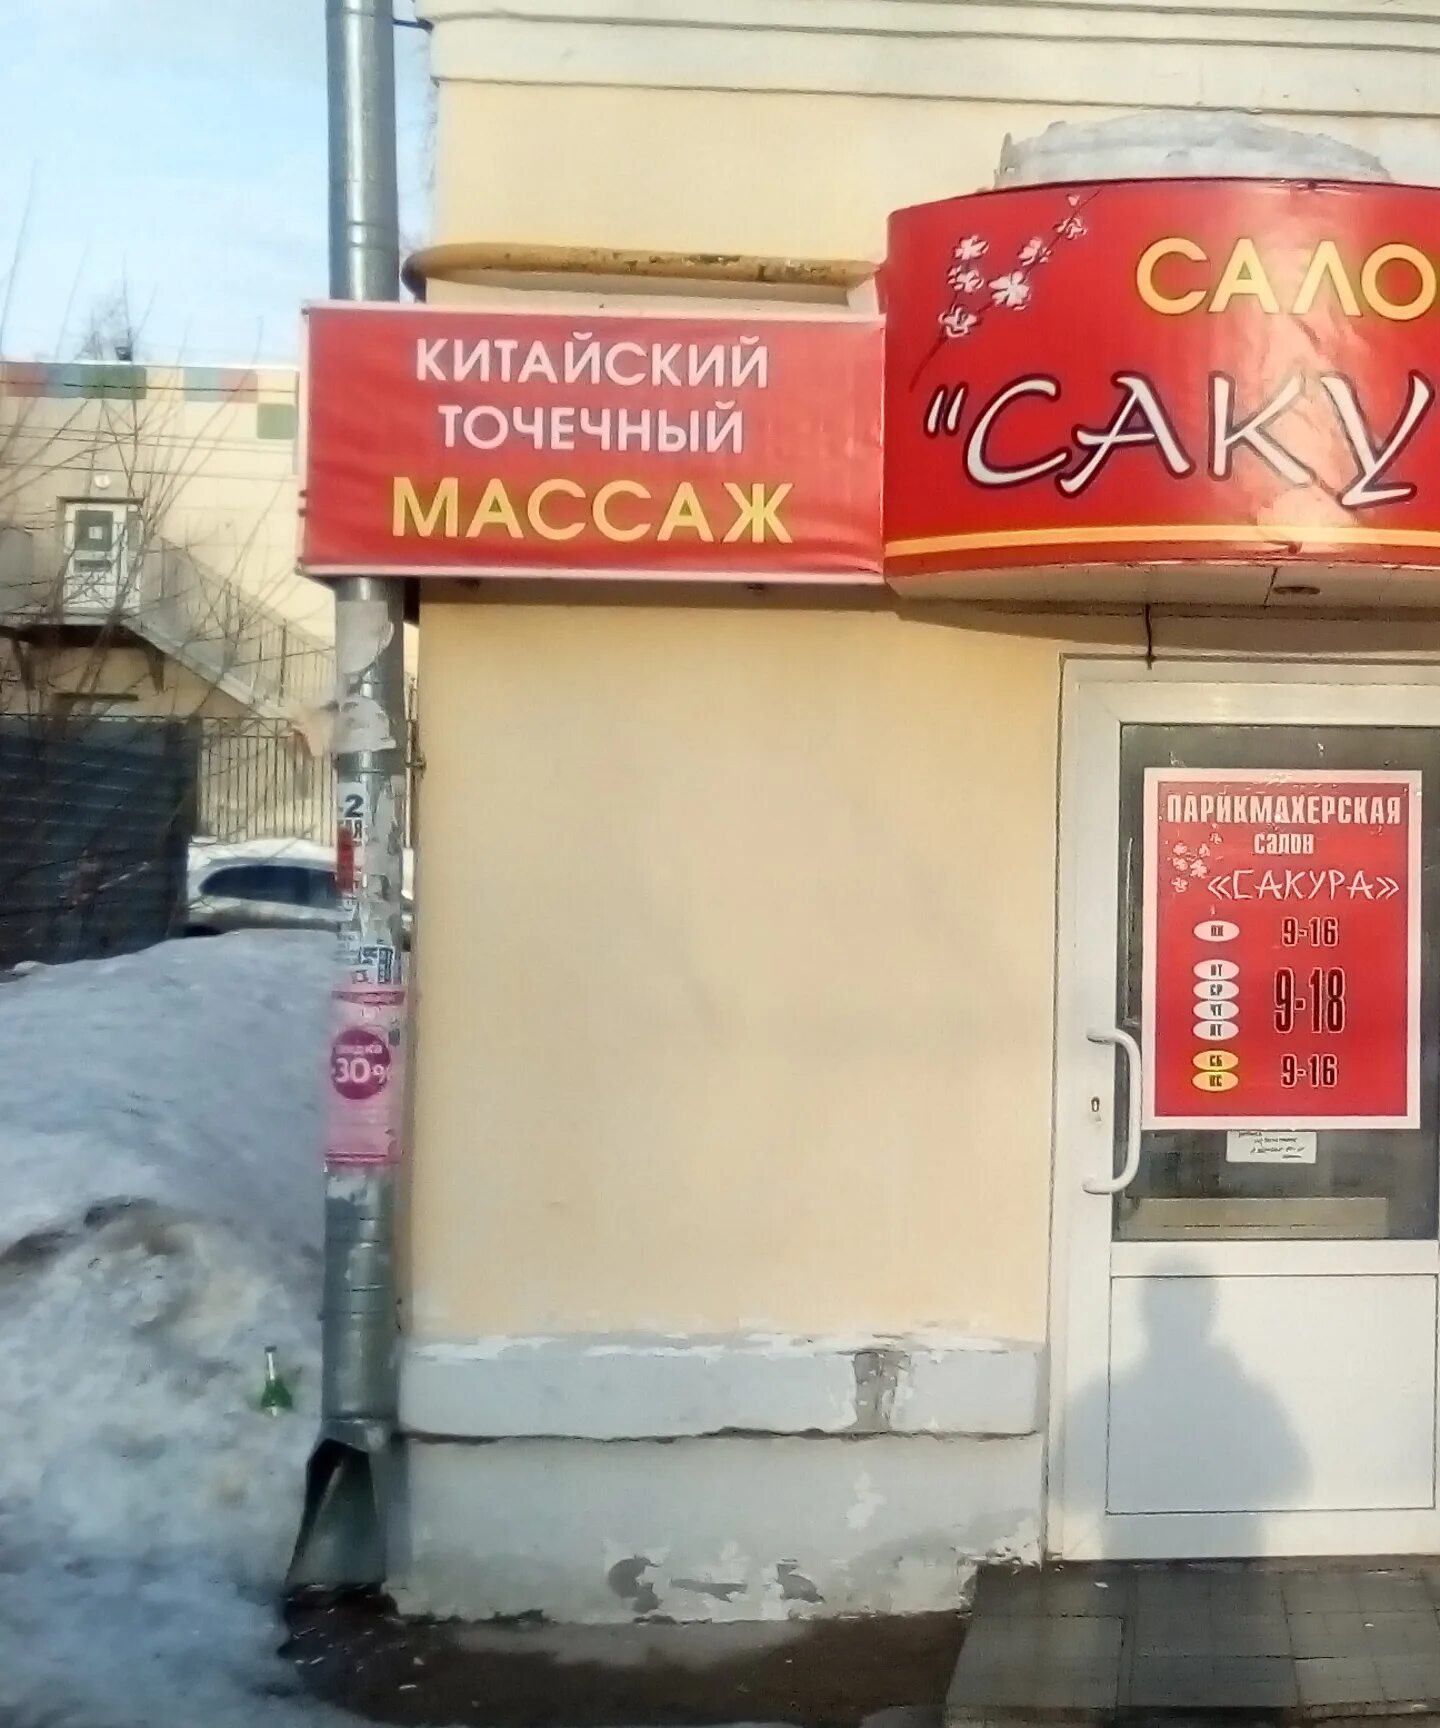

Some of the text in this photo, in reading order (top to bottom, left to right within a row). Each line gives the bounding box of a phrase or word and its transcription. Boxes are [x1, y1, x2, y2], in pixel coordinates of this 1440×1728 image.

[416, 331, 769, 389] КИТАЙСКИЙ
[437, 400, 745, 454] ТОЧЕЧНЫЙ
[391, 476, 795, 545] МАССАЖ
[1166, 793, 1402, 825] ПАРИКМАХЕРСКАЯ
[1253, 831, 1315, 855] салон
[1206, 869, 1401, 900] «САКУРА»
[1281, 916, 1340, 947] 9-16
[1273, 966, 1346, 1034] 9-18
[1279, 1053, 1338, 1088] 9-16
